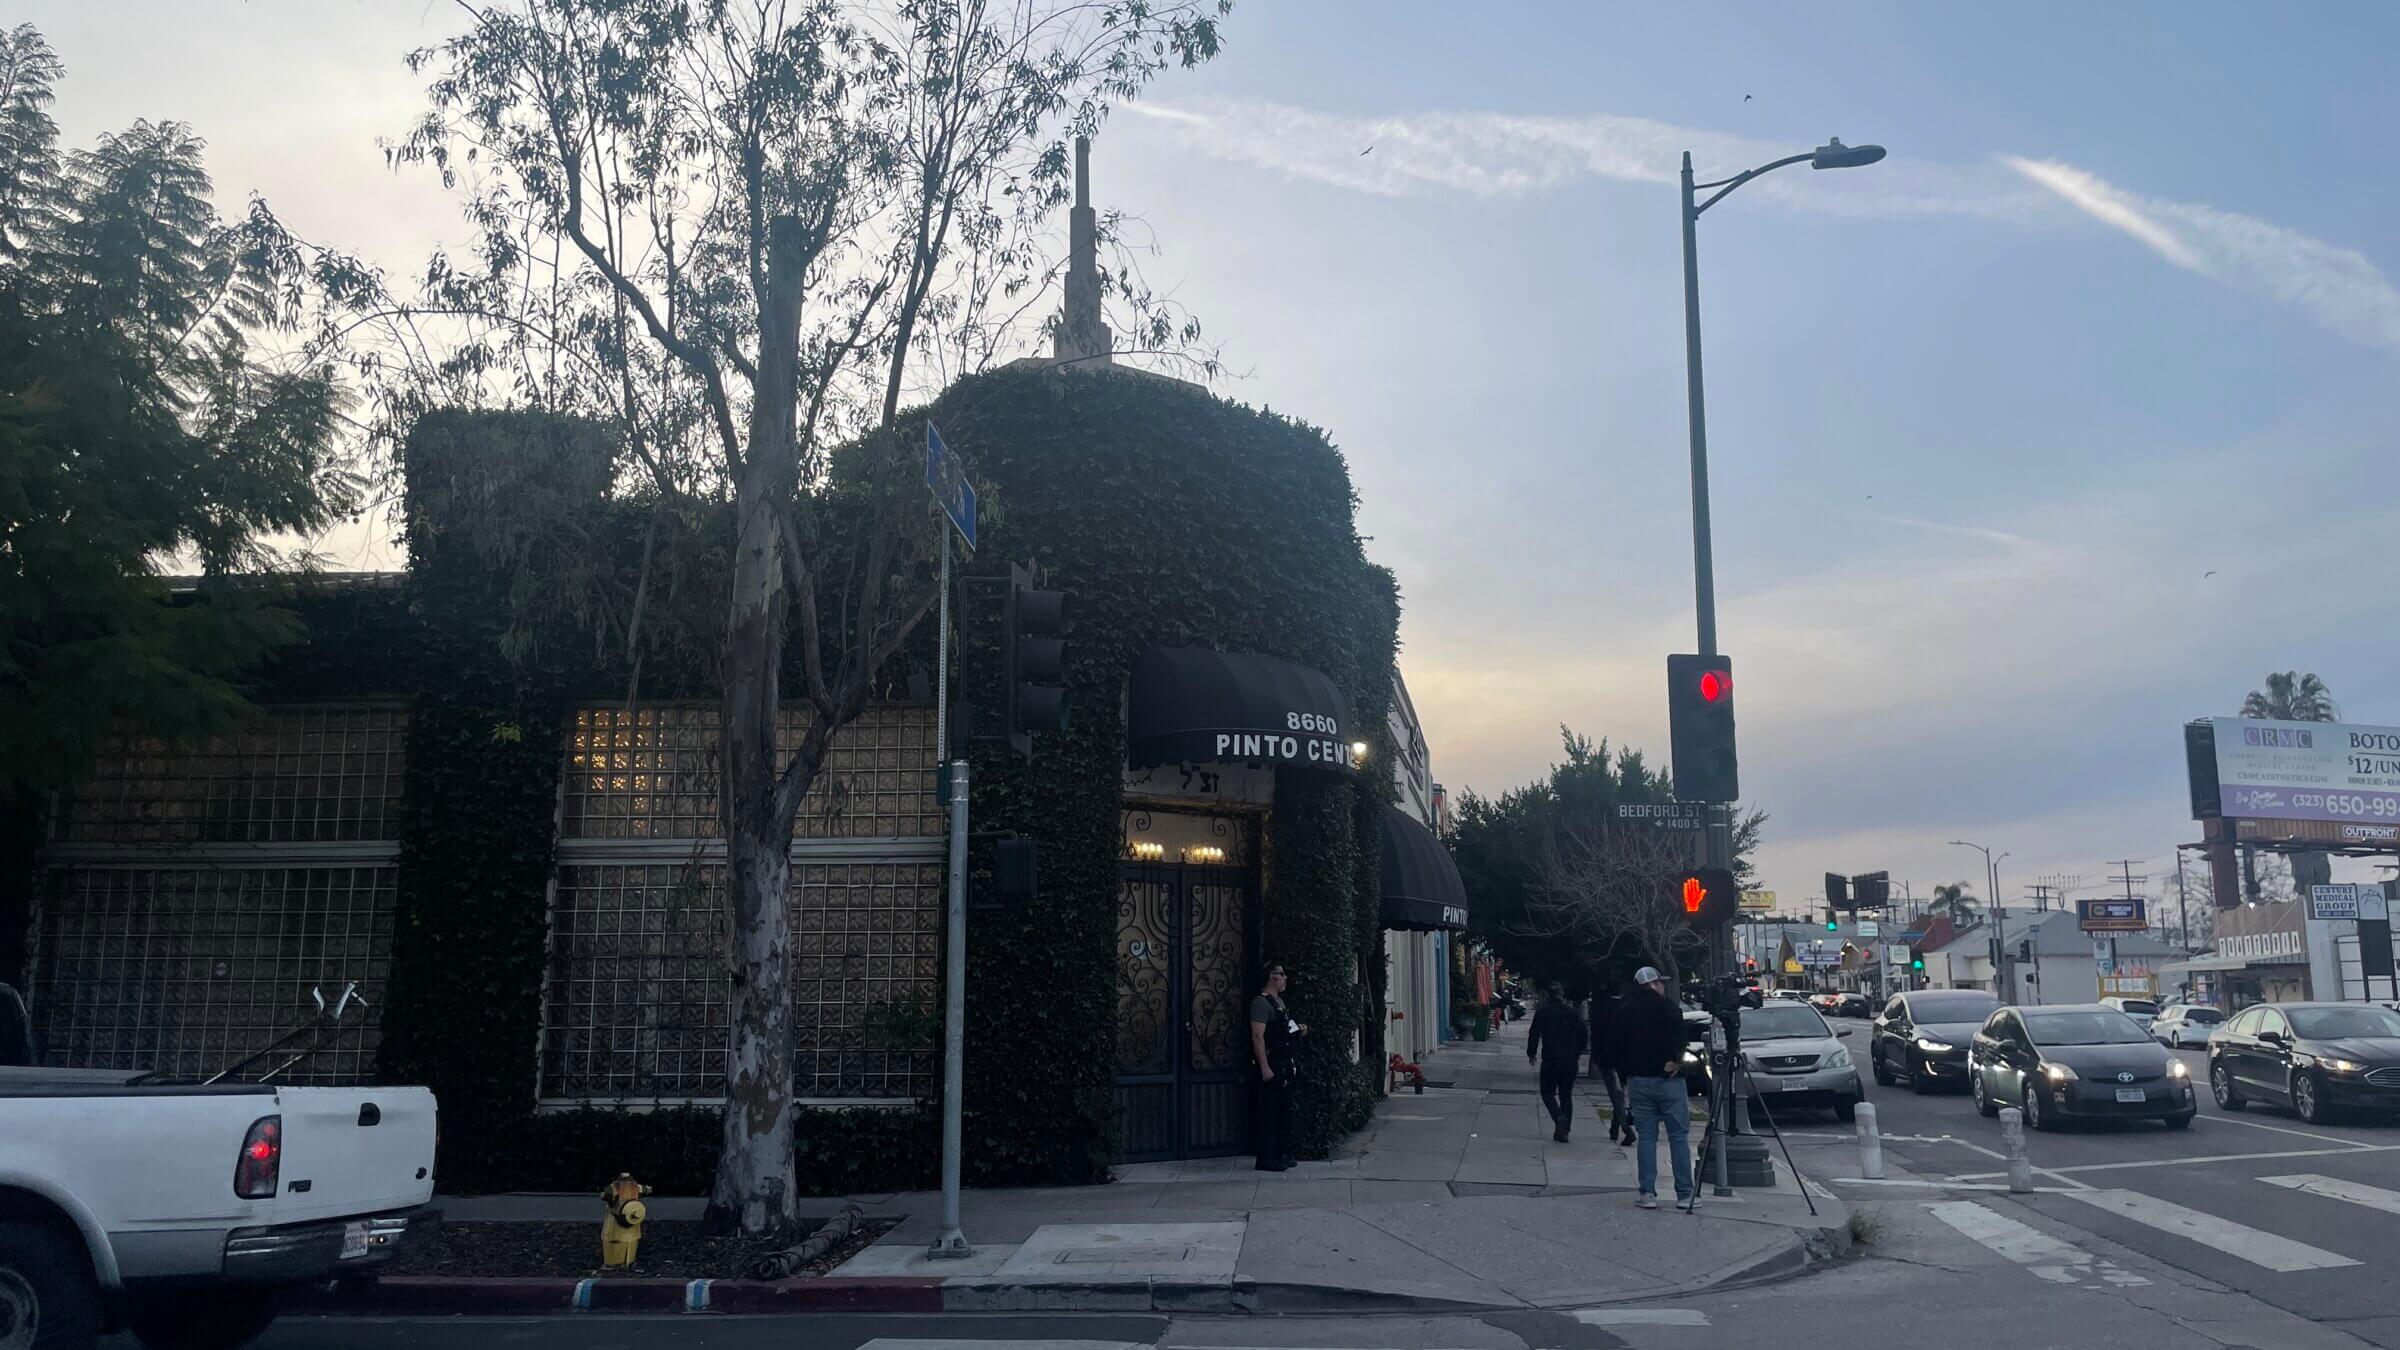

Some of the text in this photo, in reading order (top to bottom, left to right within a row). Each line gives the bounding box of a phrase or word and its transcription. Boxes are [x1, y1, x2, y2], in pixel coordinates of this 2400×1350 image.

[1287, 711, 1337, 735] 8660
[2246, 728, 2312, 747] CRMC
[2350, 732, 2400, 751] BOTO
[1216, 735, 1298, 759] PINTO
[1619, 804, 1680, 818] BEDFORD
[2292, 794, 2325, 808] (323)
[2326, 795, 2400, 817] 650-99
[1667, 819, 1690, 829] 1400
[2345, 826, 2396, 838] OUTFRONT
[2314, 886, 2353, 894] CENTURY
[2315, 894, 2355, 902] MEDICAL
